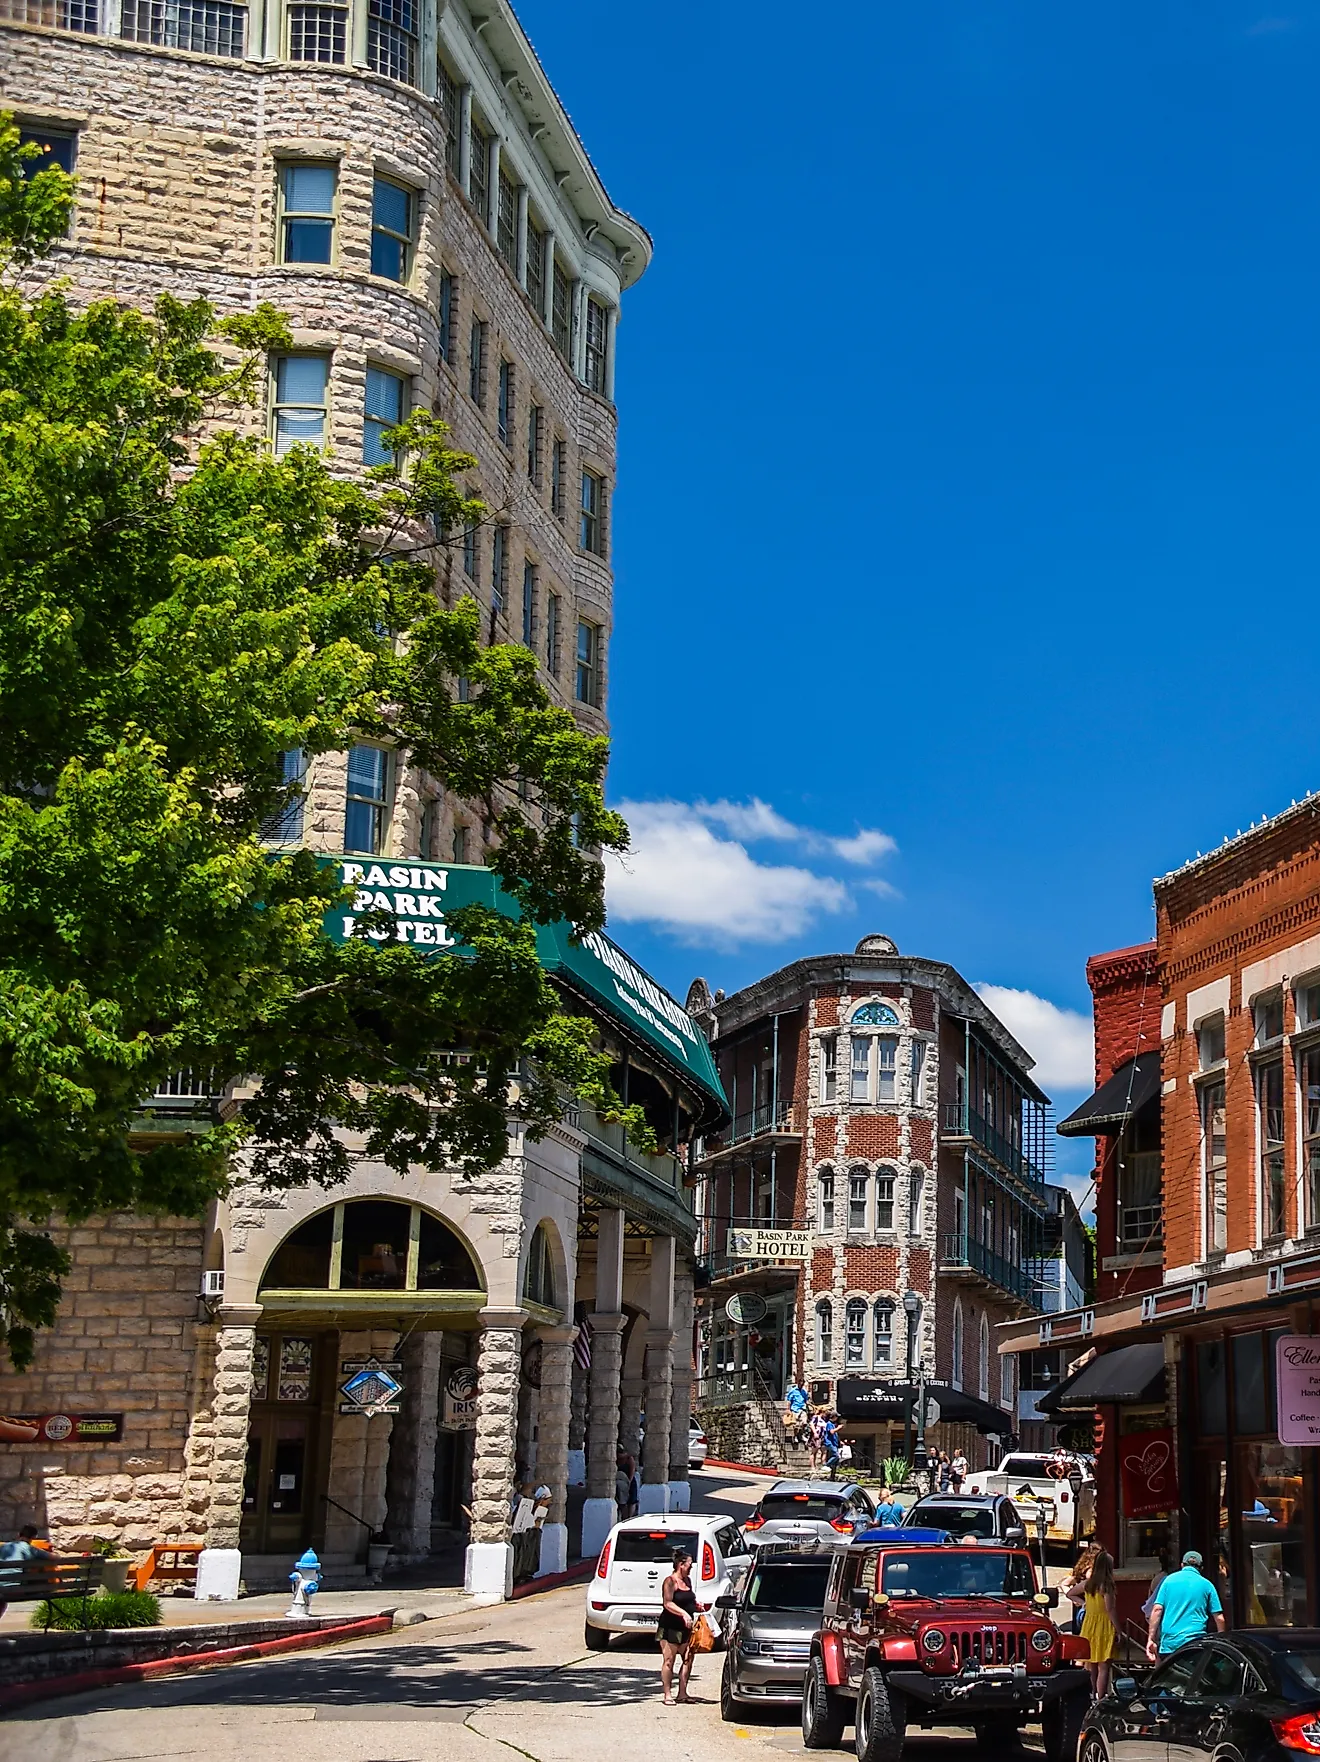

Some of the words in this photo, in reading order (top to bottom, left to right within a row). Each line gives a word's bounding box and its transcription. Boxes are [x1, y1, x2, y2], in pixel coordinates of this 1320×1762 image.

[342, 863, 449, 891] BASIN
[352, 890, 445, 917] PARK
[756, 1242, 809, 1256] HOTEL
[453, 1402, 475, 1413] IRIS
